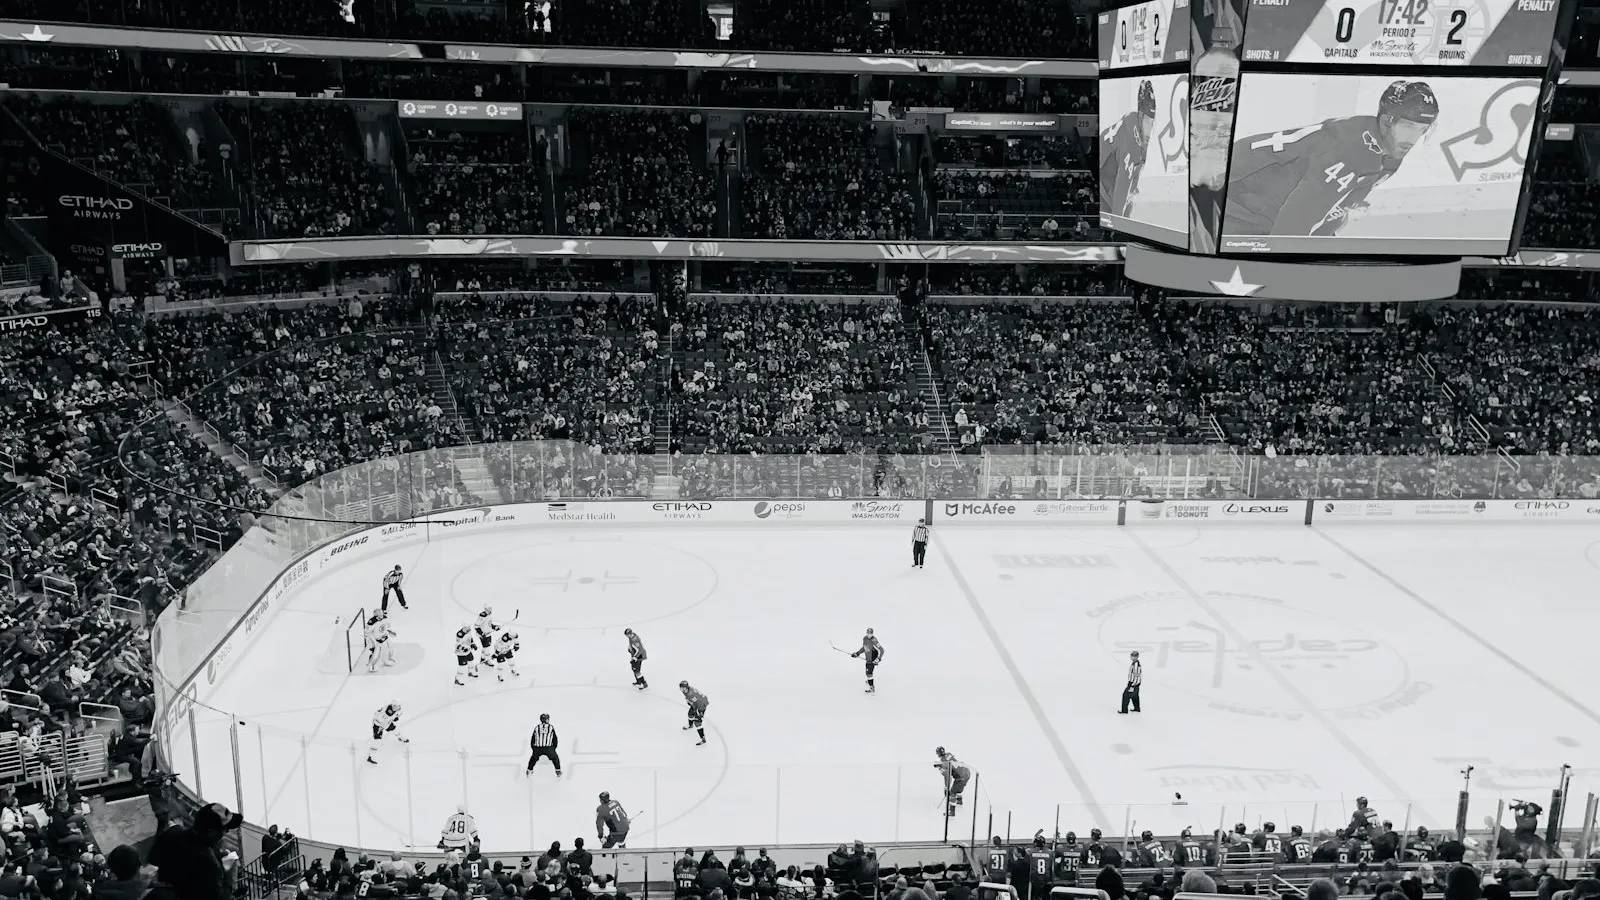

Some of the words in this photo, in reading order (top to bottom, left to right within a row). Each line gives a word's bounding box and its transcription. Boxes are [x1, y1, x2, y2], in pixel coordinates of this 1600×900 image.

[1517, 0, 1555, 12] PENALTY
[1378, 0, 1428, 25] 17:42
[1335, 7, 1356, 43] 0
[1446, 9, 1467, 45] 2
[1382, 27, 1409, 38] PERIOD
[1410, 28, 1417, 38] 2
[1382, 39, 1416, 52] Sports
[1246, 49, 1273, 60] SHOTS:
[1324, 48, 1358, 58] CAPITALS
[1438, 50, 1466, 60] BRUINS
[1507, 54, 1534, 65] SHOTS:
[914, 118, 926, 126] 215
[1324, 161, 1356, 193] 44
[58, 195, 134, 210] ETIHAD
[73, 209, 121, 220] AIRWAYS
[70, 244, 105, 256] ETIHAD
[111, 242, 163, 252] ETIHAD
[86, 309, 102, 318] 115
[652, 502, 712, 511] ETIHAD
[773, 502, 806, 514] pepsi
[866, 501, 904, 513] Sports
[962, 502, 1016, 515] McAfee
[1240, 505, 1289, 513] LEXUS
[1514, 501, 1570, 510] ETIHAD
[495, 514, 515, 522] Bank
[547, 512, 585, 521] MedStar
[586, 512, 616, 520] Health
[330, 535, 369, 556] BOEING
[449, 820, 465, 834] 48
[1186, 846, 1201, 862] 10
[991, 854, 1006, 870] 31
[1037, 858, 1047, 875] 8
[470, 863, 480, 878] 8
[358, 881, 370, 897] 8
